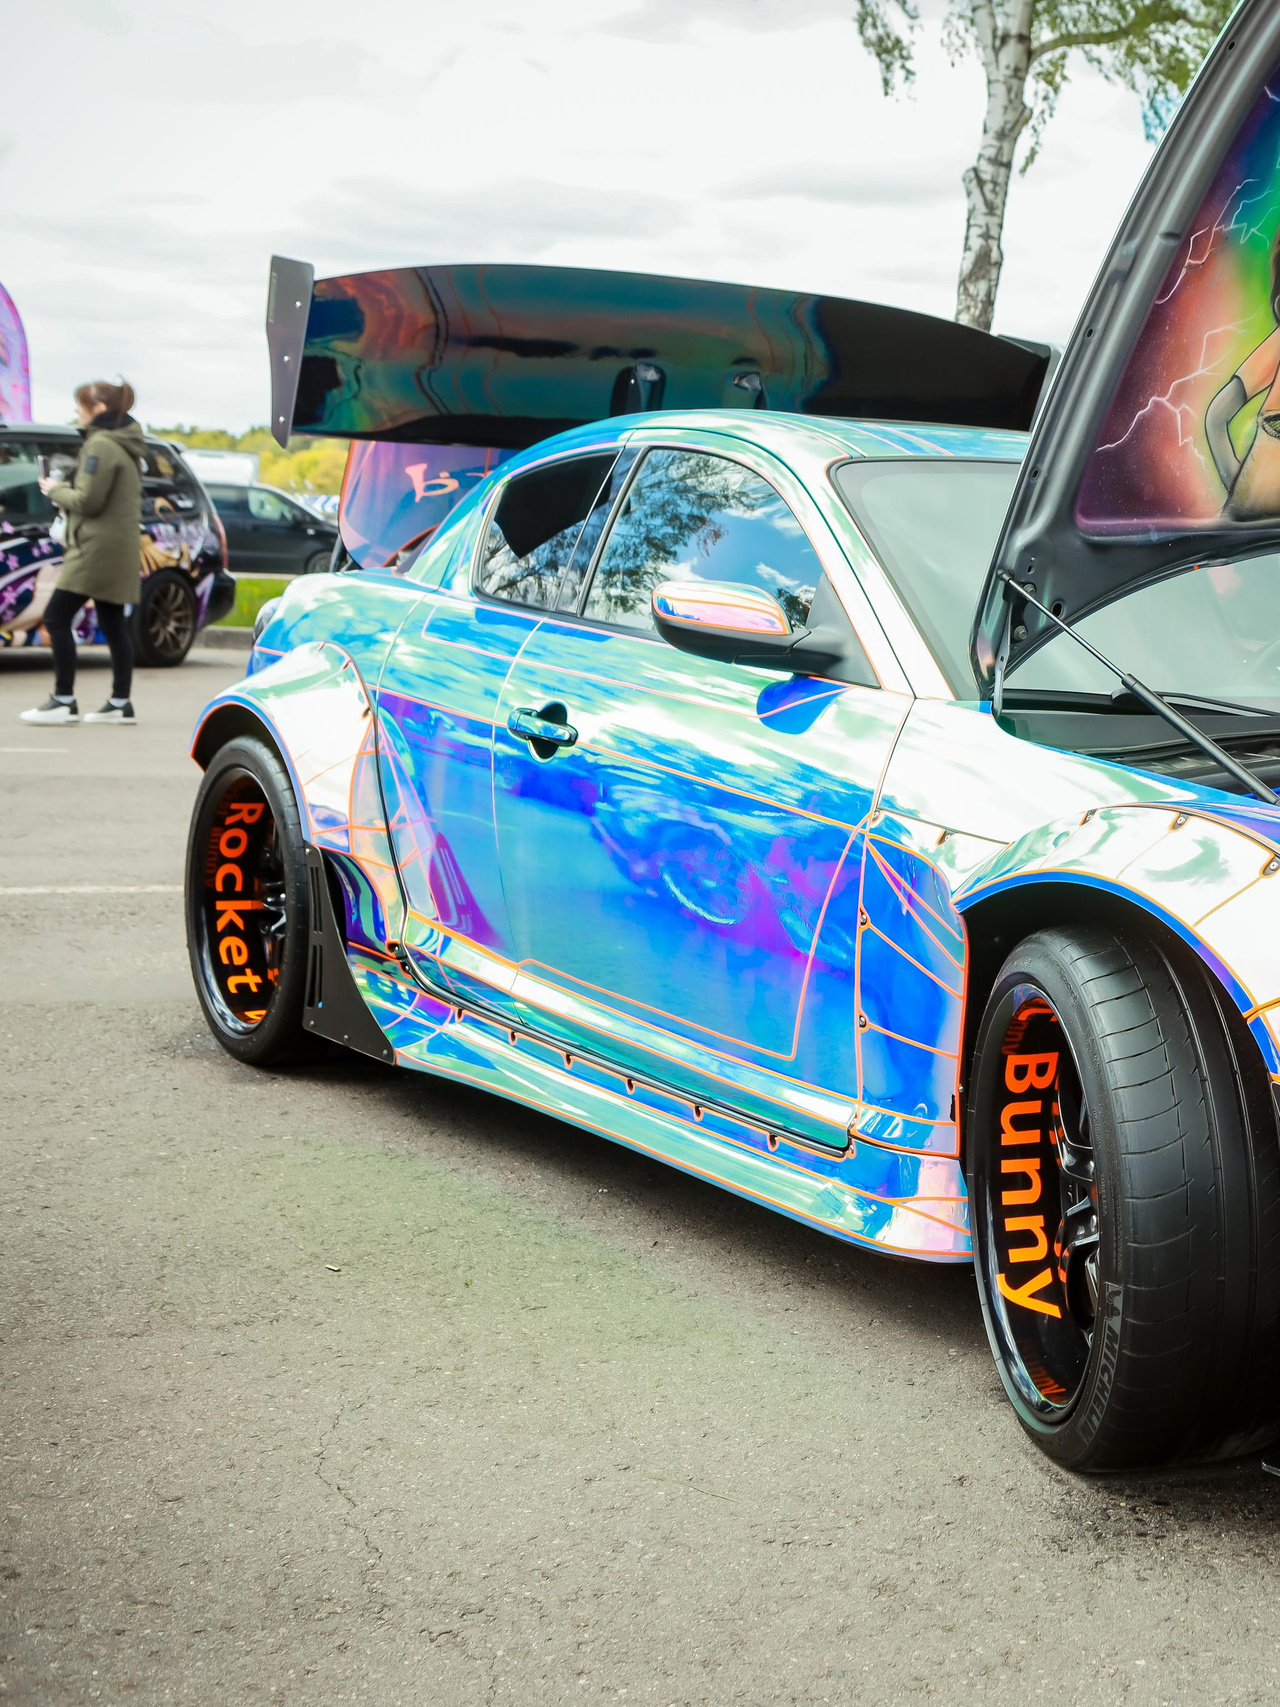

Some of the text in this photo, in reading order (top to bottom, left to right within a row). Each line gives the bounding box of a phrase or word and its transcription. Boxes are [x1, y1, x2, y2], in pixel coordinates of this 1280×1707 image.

[215, 803, 265, 994] Rocket
[996, 1051, 1062, 1320] Bunny
[1078, 1324, 1120, 1445] MICHELIN
